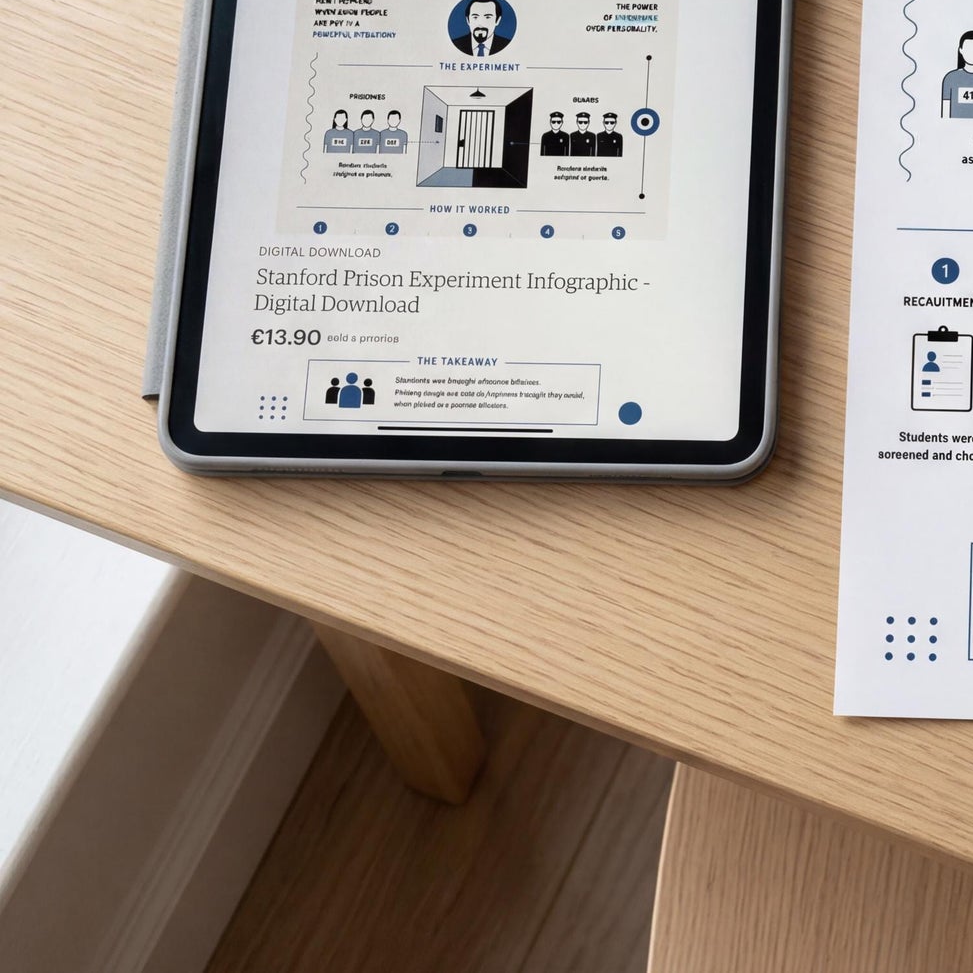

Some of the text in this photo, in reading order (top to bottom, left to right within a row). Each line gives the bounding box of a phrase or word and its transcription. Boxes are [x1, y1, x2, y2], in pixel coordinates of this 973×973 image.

[440, 63, 520, 71] THE EXPERIMENT
[430, 205, 510, 214] HOW IT WORKED
[259, 247, 381, 257] DIGITAL DOWNLOAD
[942, 264, 948, 278] 1
[257, 268, 638, 294] Stanford Prison Experiment Infographic
[254, 294, 419, 315] Digital Download
[251, 329, 321, 345] €13.90
[417, 357, 498, 366] THE TAKEAWAY
[899, 432, 949, 443] Students
[932, 450, 952, 460] and
